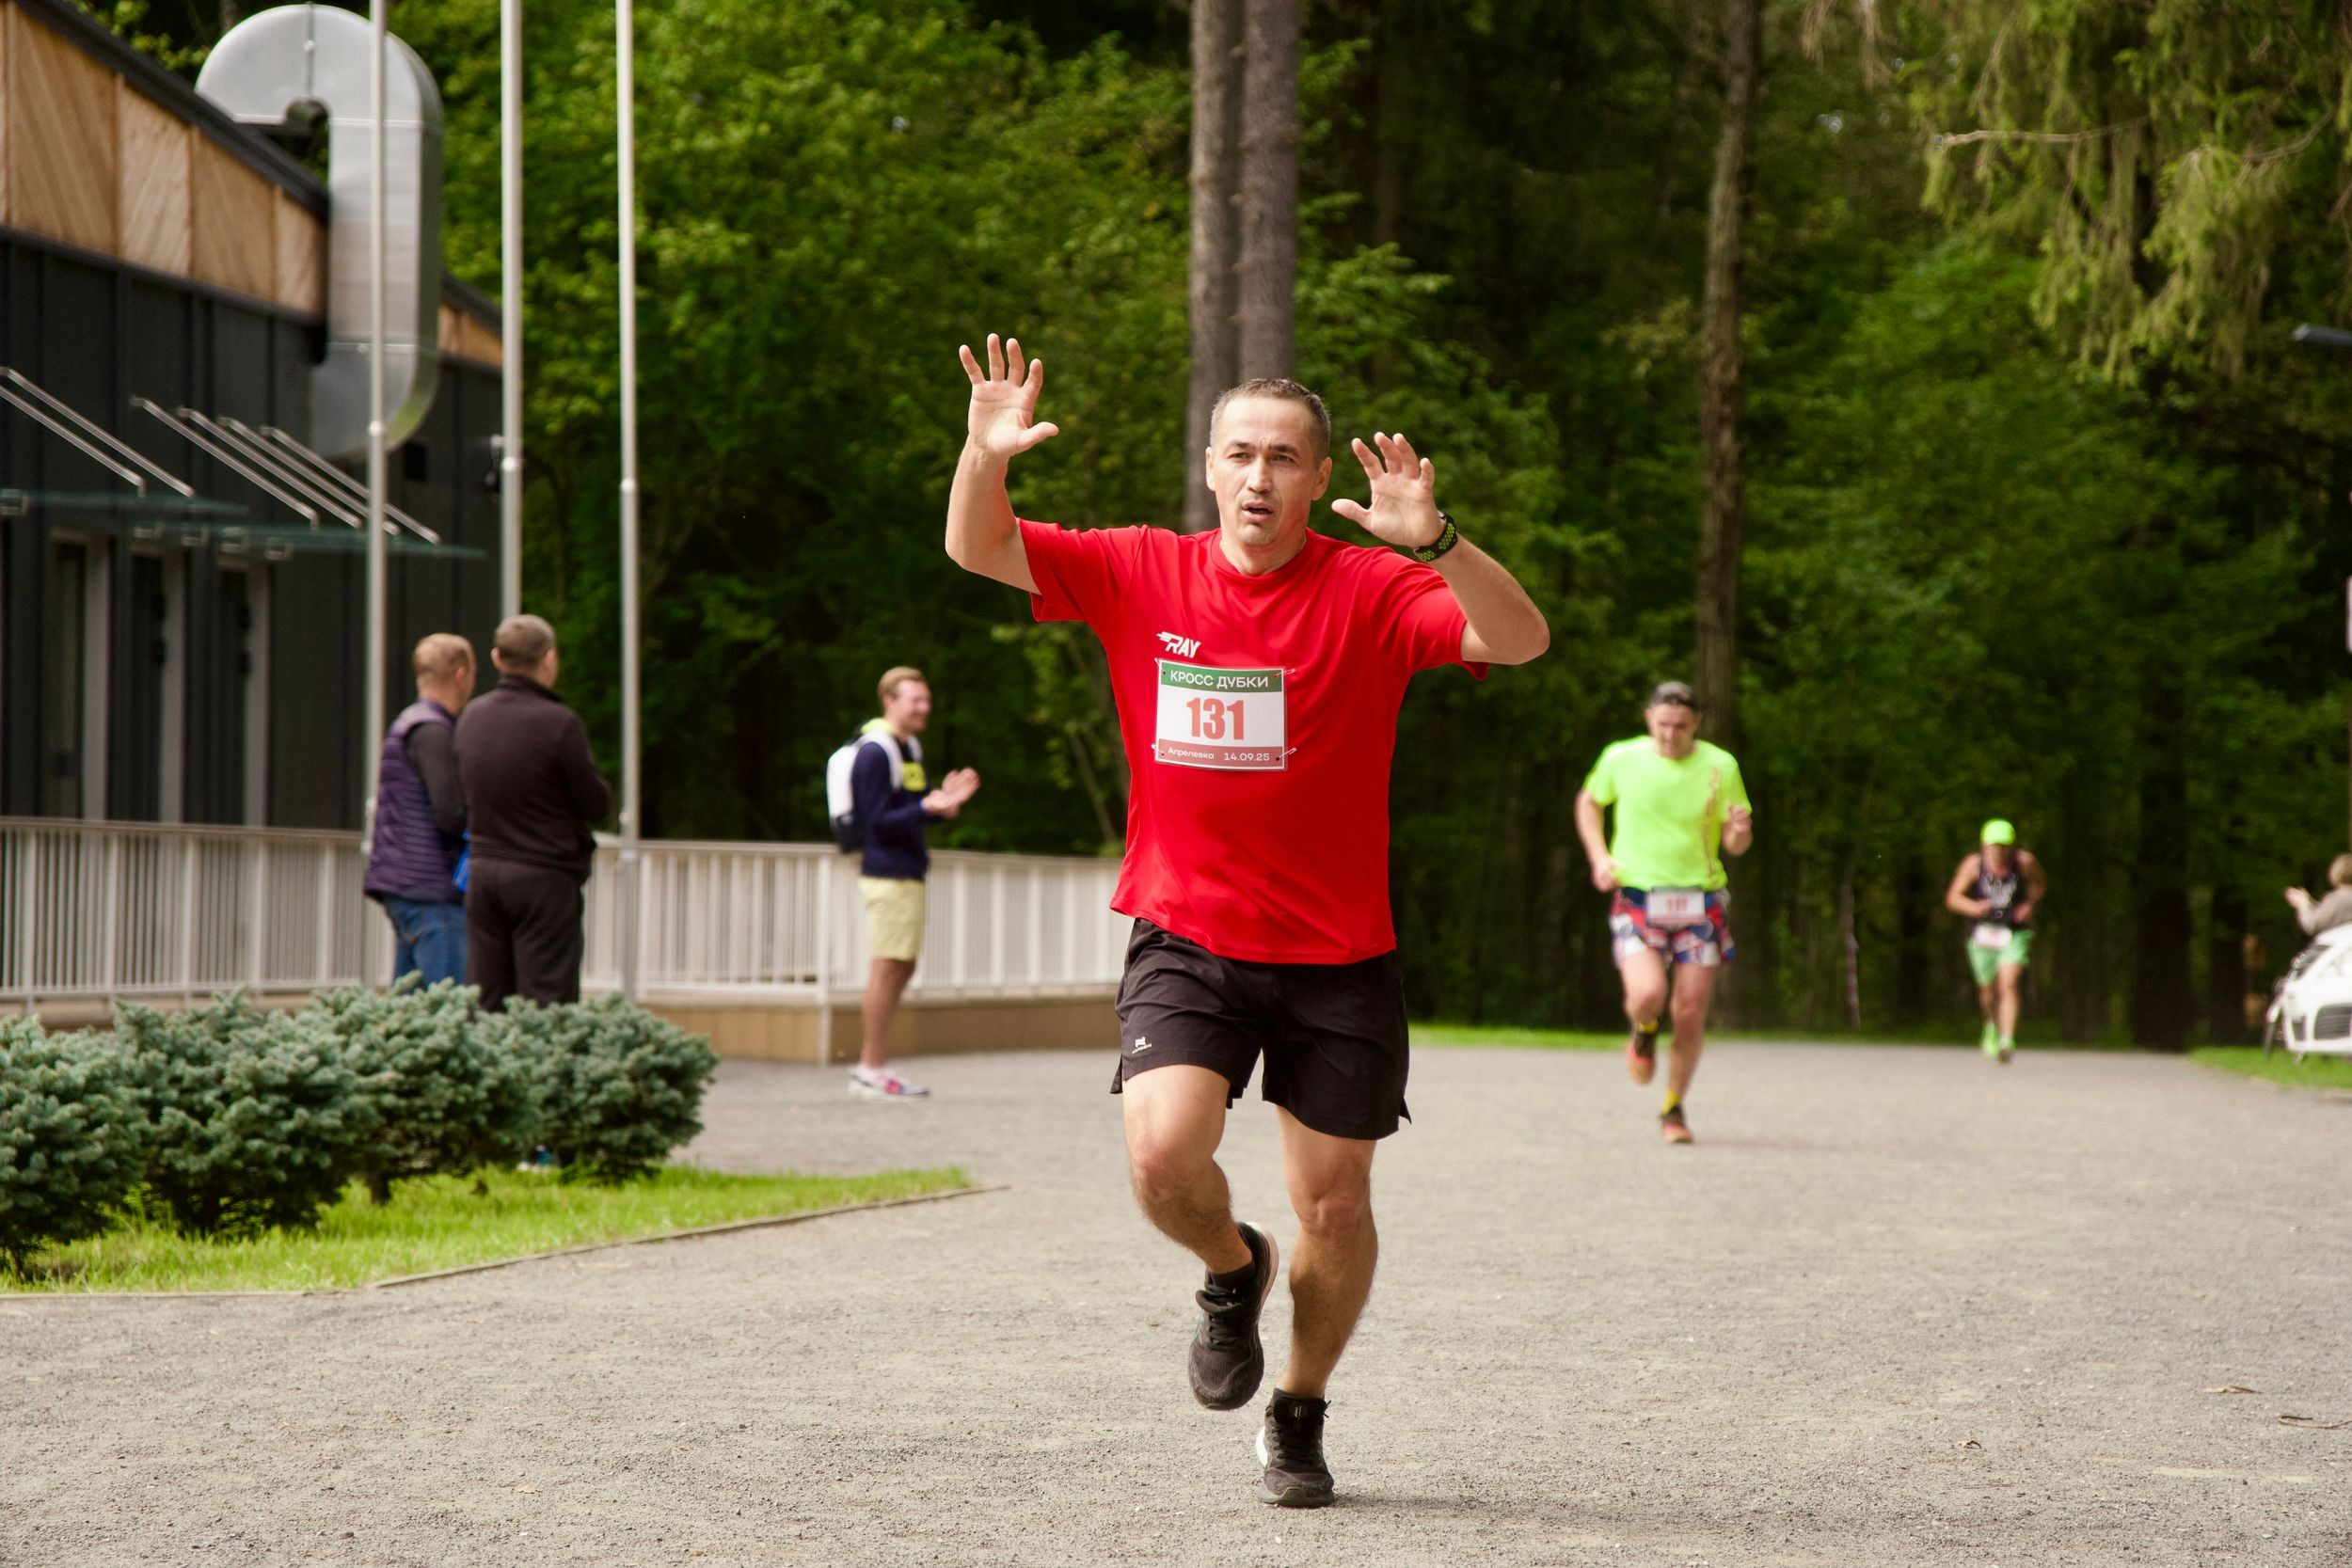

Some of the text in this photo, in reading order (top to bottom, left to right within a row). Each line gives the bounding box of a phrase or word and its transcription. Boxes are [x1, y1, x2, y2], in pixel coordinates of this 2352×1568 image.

[1156, 631, 1201, 658] RAY
[1170, 670, 1269, 689] КРОСС ДУБКИ
[1186, 697, 1244, 740] 131
[1168, 747, 1270, 761] Апрелевка 14.09.25
